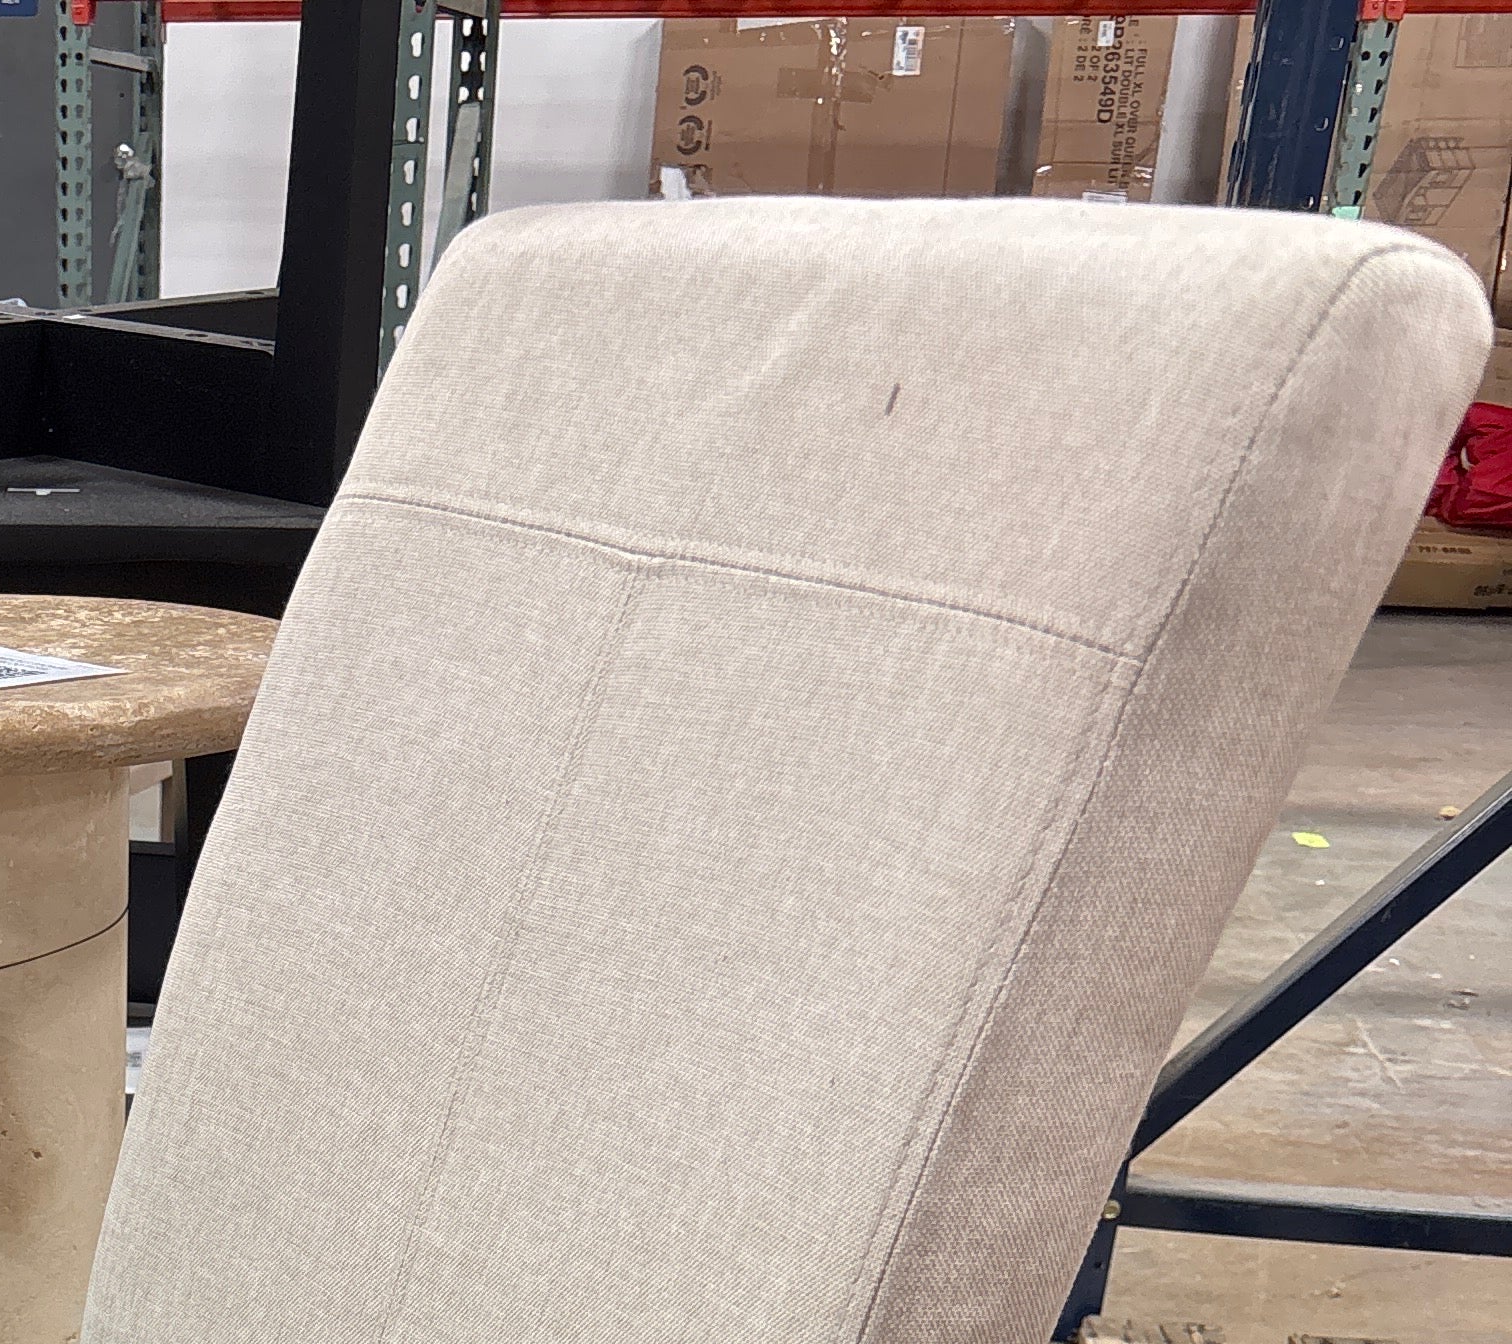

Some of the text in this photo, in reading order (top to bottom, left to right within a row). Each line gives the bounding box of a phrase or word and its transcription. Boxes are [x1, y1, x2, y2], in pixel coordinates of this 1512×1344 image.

[1123, 48, 1135, 67] LIT
[1133, 48, 1148, 81] FULL
[1116, 69, 1133, 119] DOUBLE
[1132, 82, 1145, 97] XL
[1127, 100, 1142, 134] OVER
[1113, 123, 1126, 138] XL
